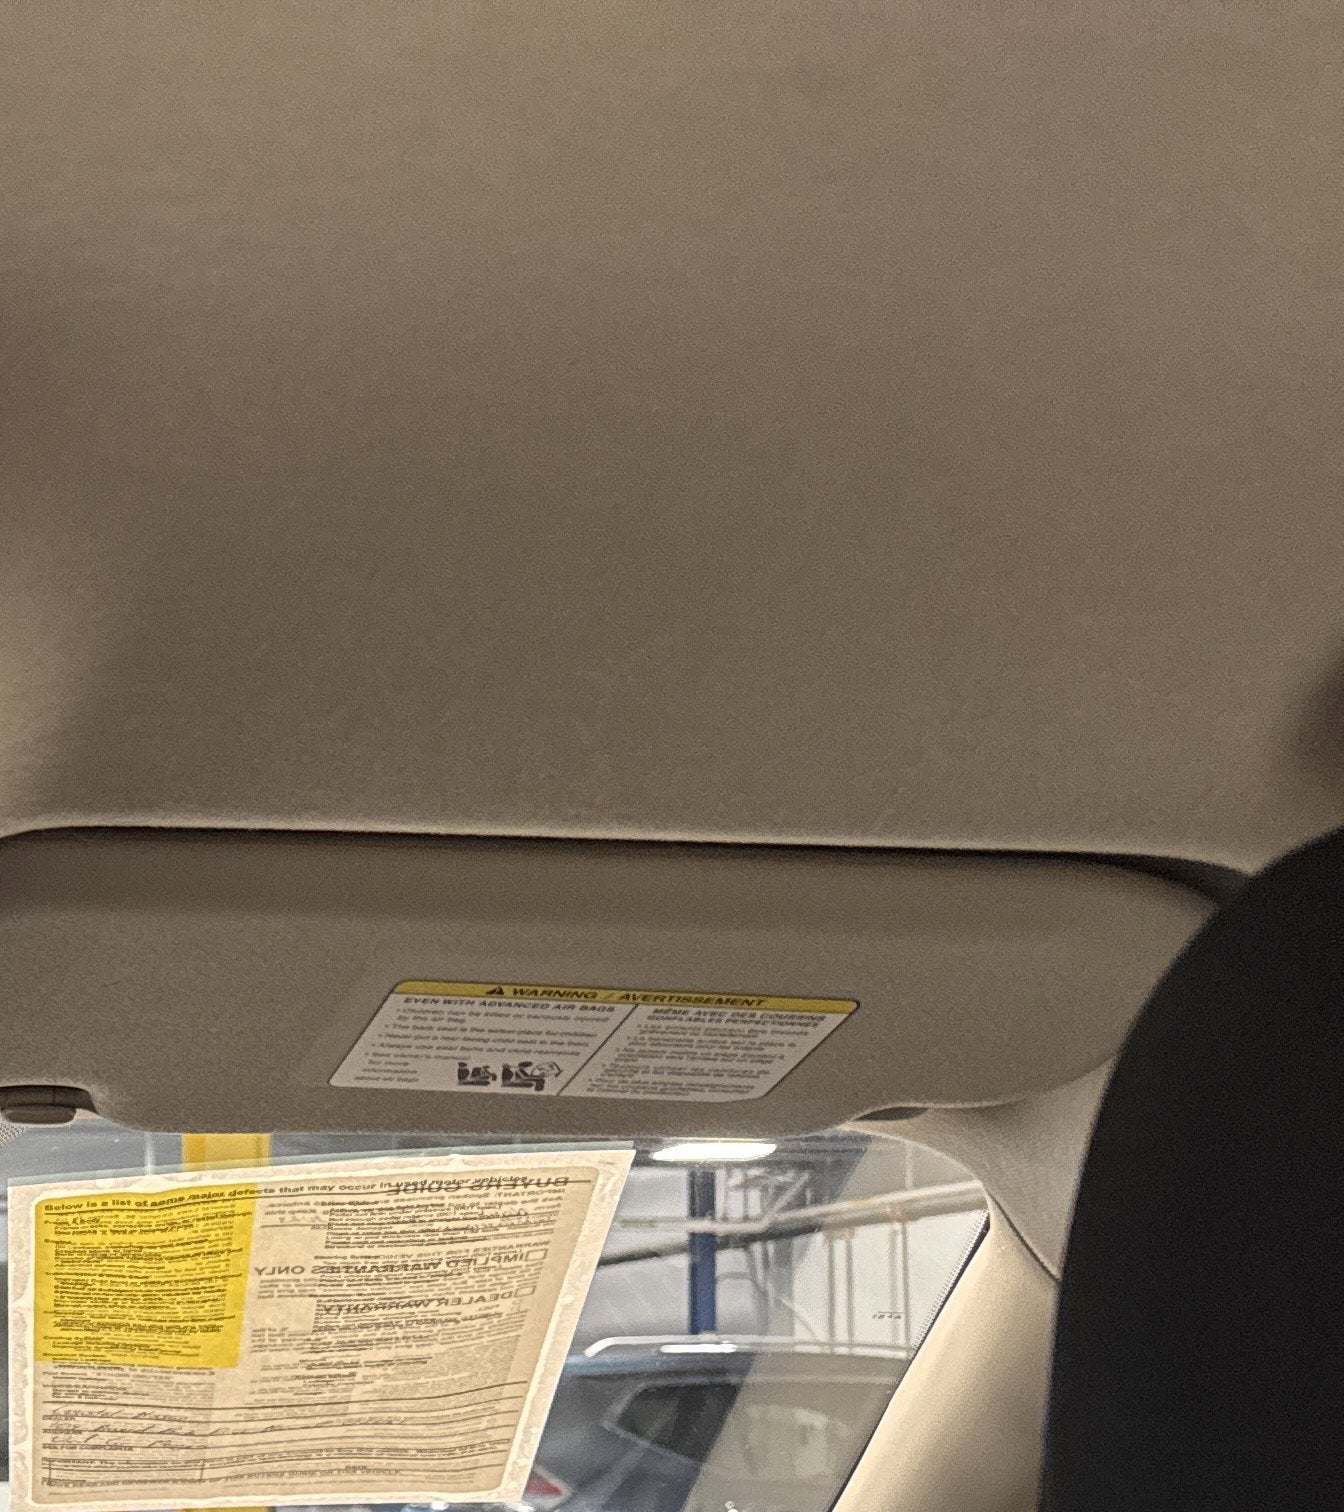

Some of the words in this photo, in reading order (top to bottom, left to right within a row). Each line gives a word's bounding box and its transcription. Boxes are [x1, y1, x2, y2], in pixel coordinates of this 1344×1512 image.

[442, 998, 476, 1007] WITH
[478, 1000, 551, 1010] ADVANCED
[512, 988, 598, 1000] WARNING
[618, 993, 768, 1007] AVERTISSEMENT
[45, 1203, 83, 1212] Below
[86, 1201, 97, 1209] is
[111, 1199, 132, 1207] list
[134, 1199, 149, 1208] of
[150, 1195, 186, 1208] some
[187, 1191, 226, 1203] major
[228, 1186, 275, 1199] defects
[279, 1185, 305, 1194] that
[307, 1183, 335, 1194] may
[338, 1182, 377, 1191] occur
